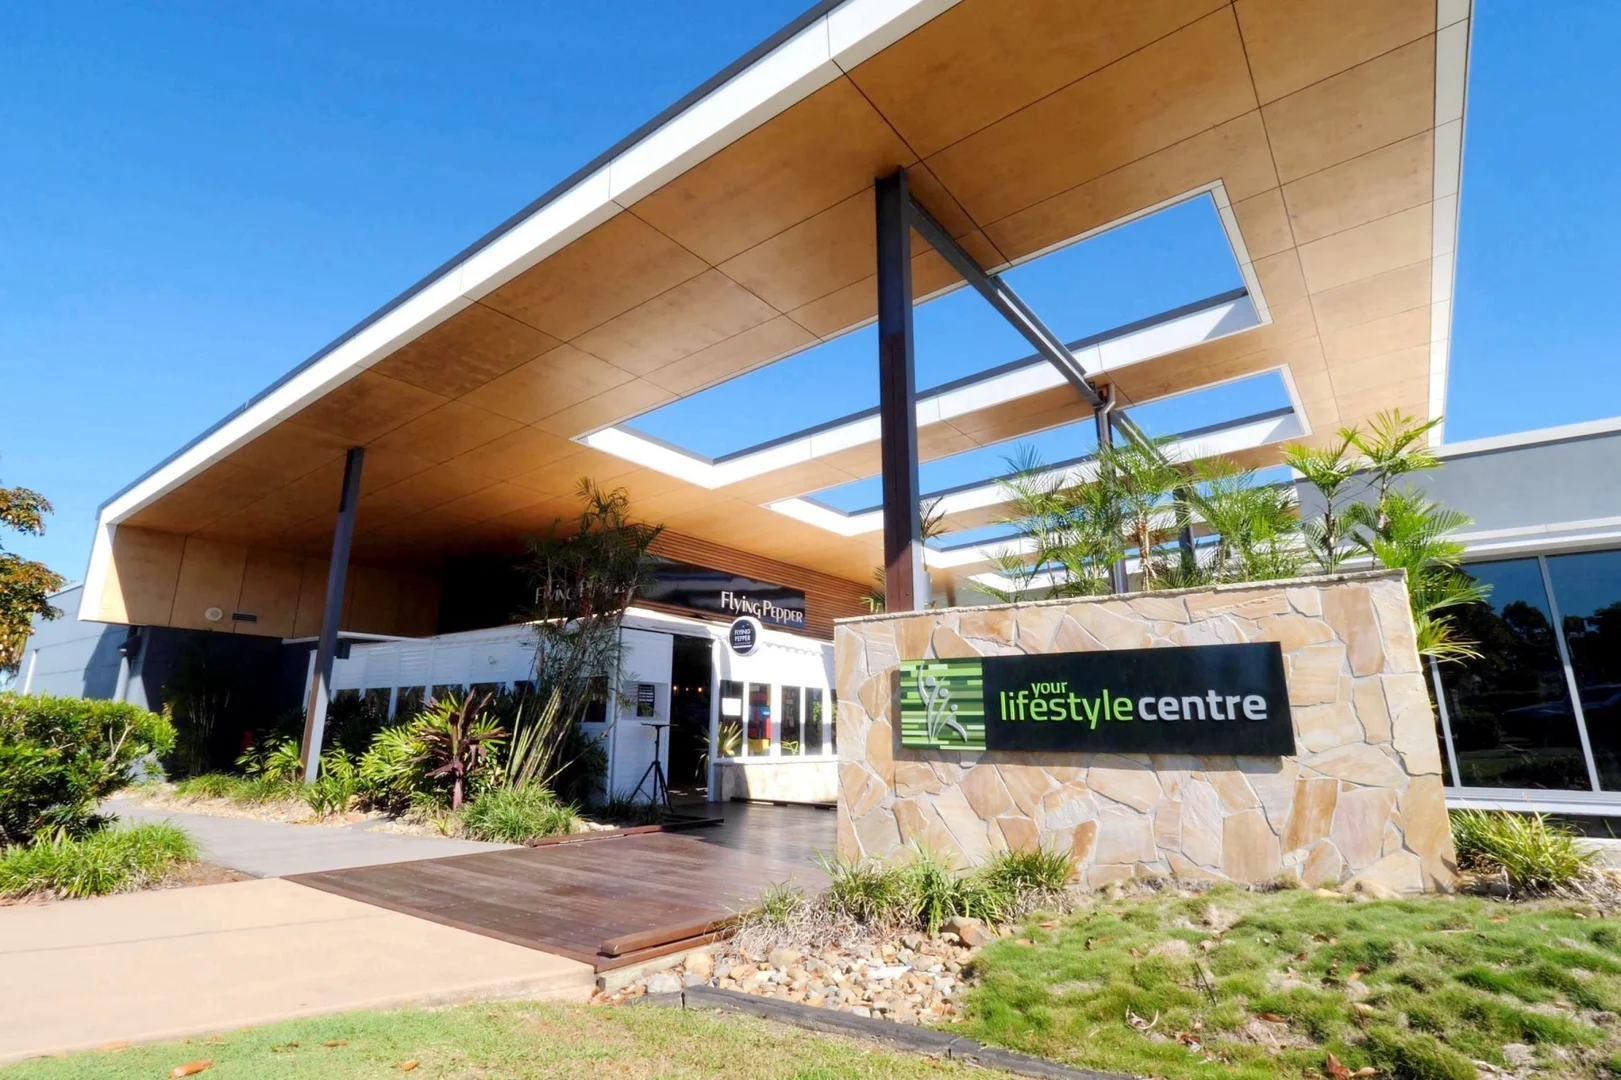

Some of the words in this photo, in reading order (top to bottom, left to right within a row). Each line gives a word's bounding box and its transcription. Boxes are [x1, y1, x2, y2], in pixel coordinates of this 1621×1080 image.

[1031, 681, 1068, 698] your
[1000, 689, 1133, 729] lifestyle
[1138, 689, 1268, 721] centre
